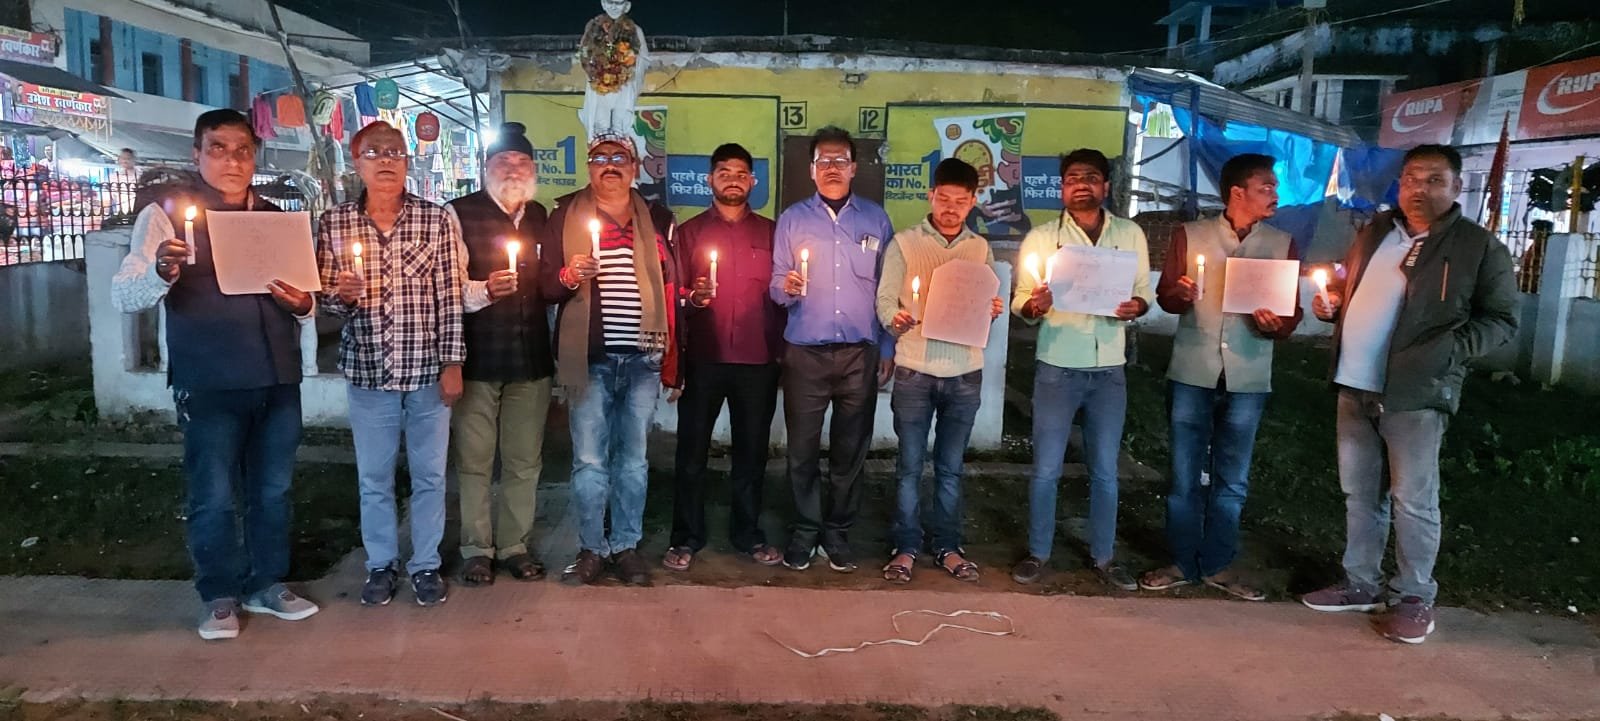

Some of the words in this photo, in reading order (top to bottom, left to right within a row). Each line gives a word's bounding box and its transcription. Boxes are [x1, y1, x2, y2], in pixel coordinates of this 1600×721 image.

[1556, 72, 1600, 95] RUP
[1405, 98, 1443, 116] RUPA
[782, 106, 804, 126] 13
[862, 110, 879, 130] 12
[557, 135, 577, 175] 1
[671, 170, 696, 182] पहले
[886, 163, 922, 177] भारत
[886, 177, 905, 189] का
[1024, 173, 1048, 187] पहले
[670, 182, 693, 196] फिर
[1024, 186, 1045, 199] फिर
